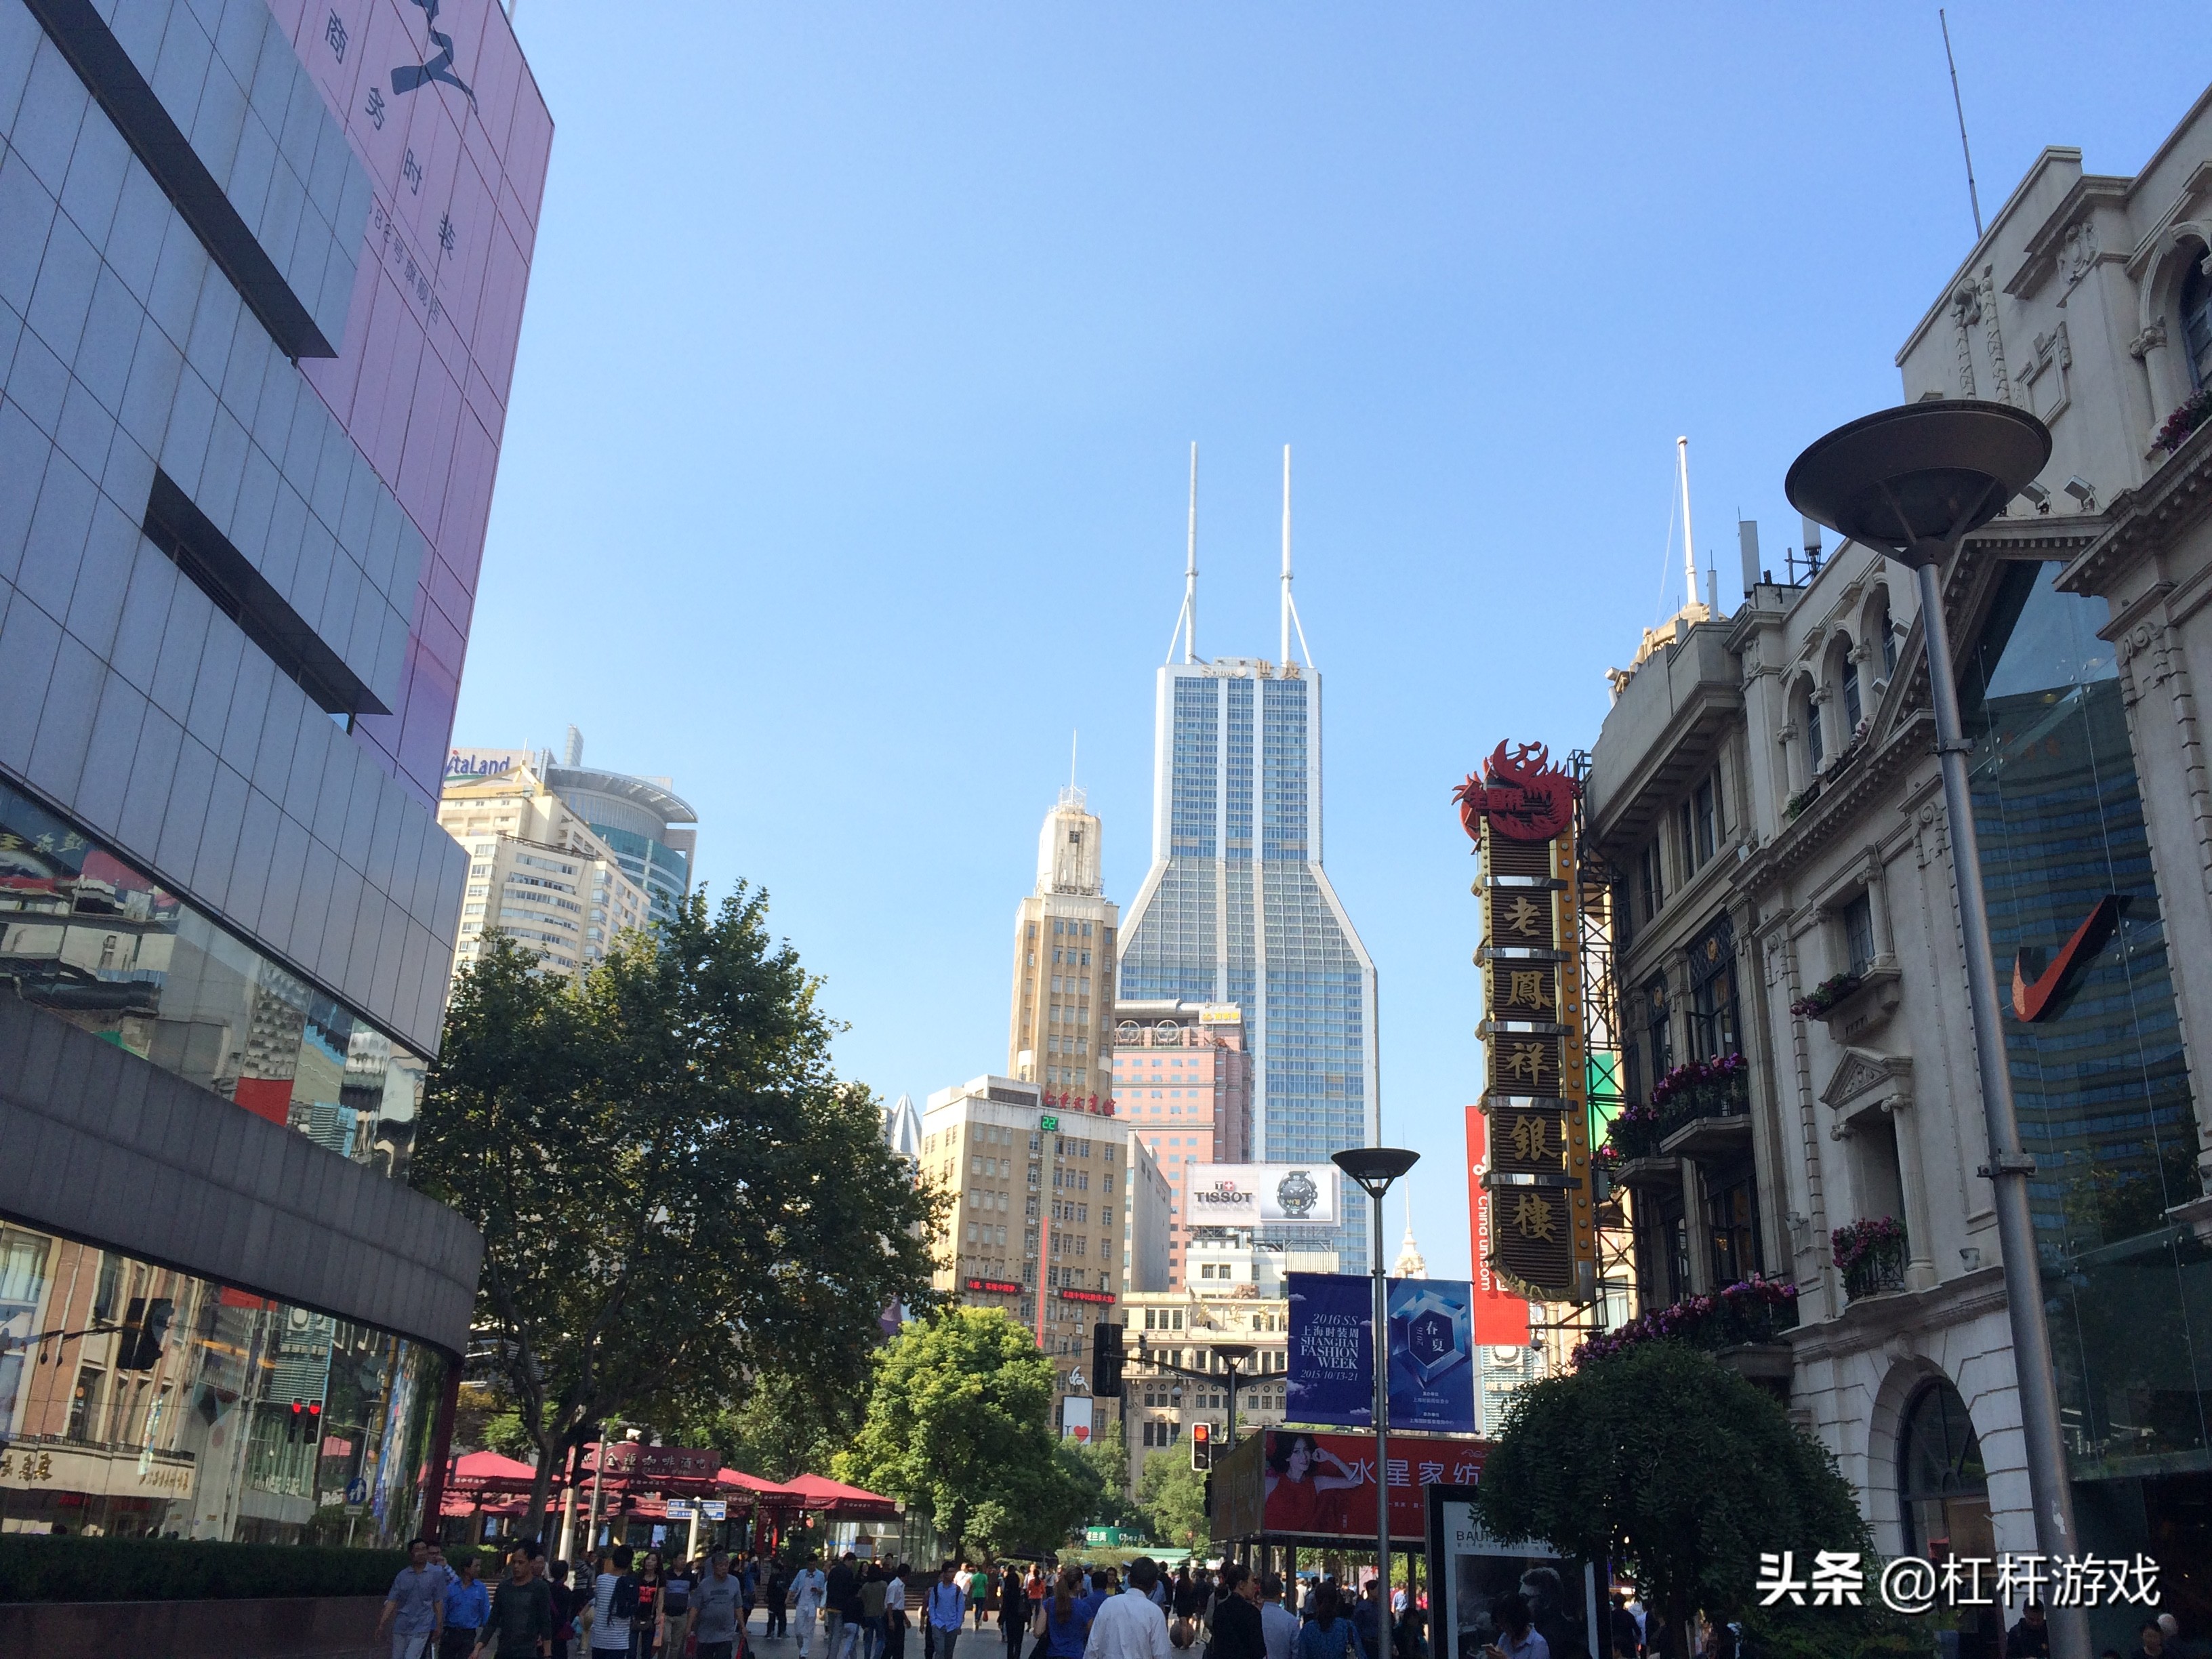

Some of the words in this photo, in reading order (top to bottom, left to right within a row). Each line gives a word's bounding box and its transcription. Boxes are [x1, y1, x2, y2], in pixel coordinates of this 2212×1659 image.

[1193, 1191, 1252, 1203] TISSOT
[1312, 1313, 1341, 1326] 2016
[1342, 1315, 1359, 1326] SS
[1301, 1325, 1359, 1339] 上海时装周
[1300, 1336, 1359, 1348] SHANGHAI
[1300, 1345, 1359, 1359] FASHION
[1317, 1356, 1358, 1370] WEEK
[1349, 1458, 1481, 1487] 水星家纺
